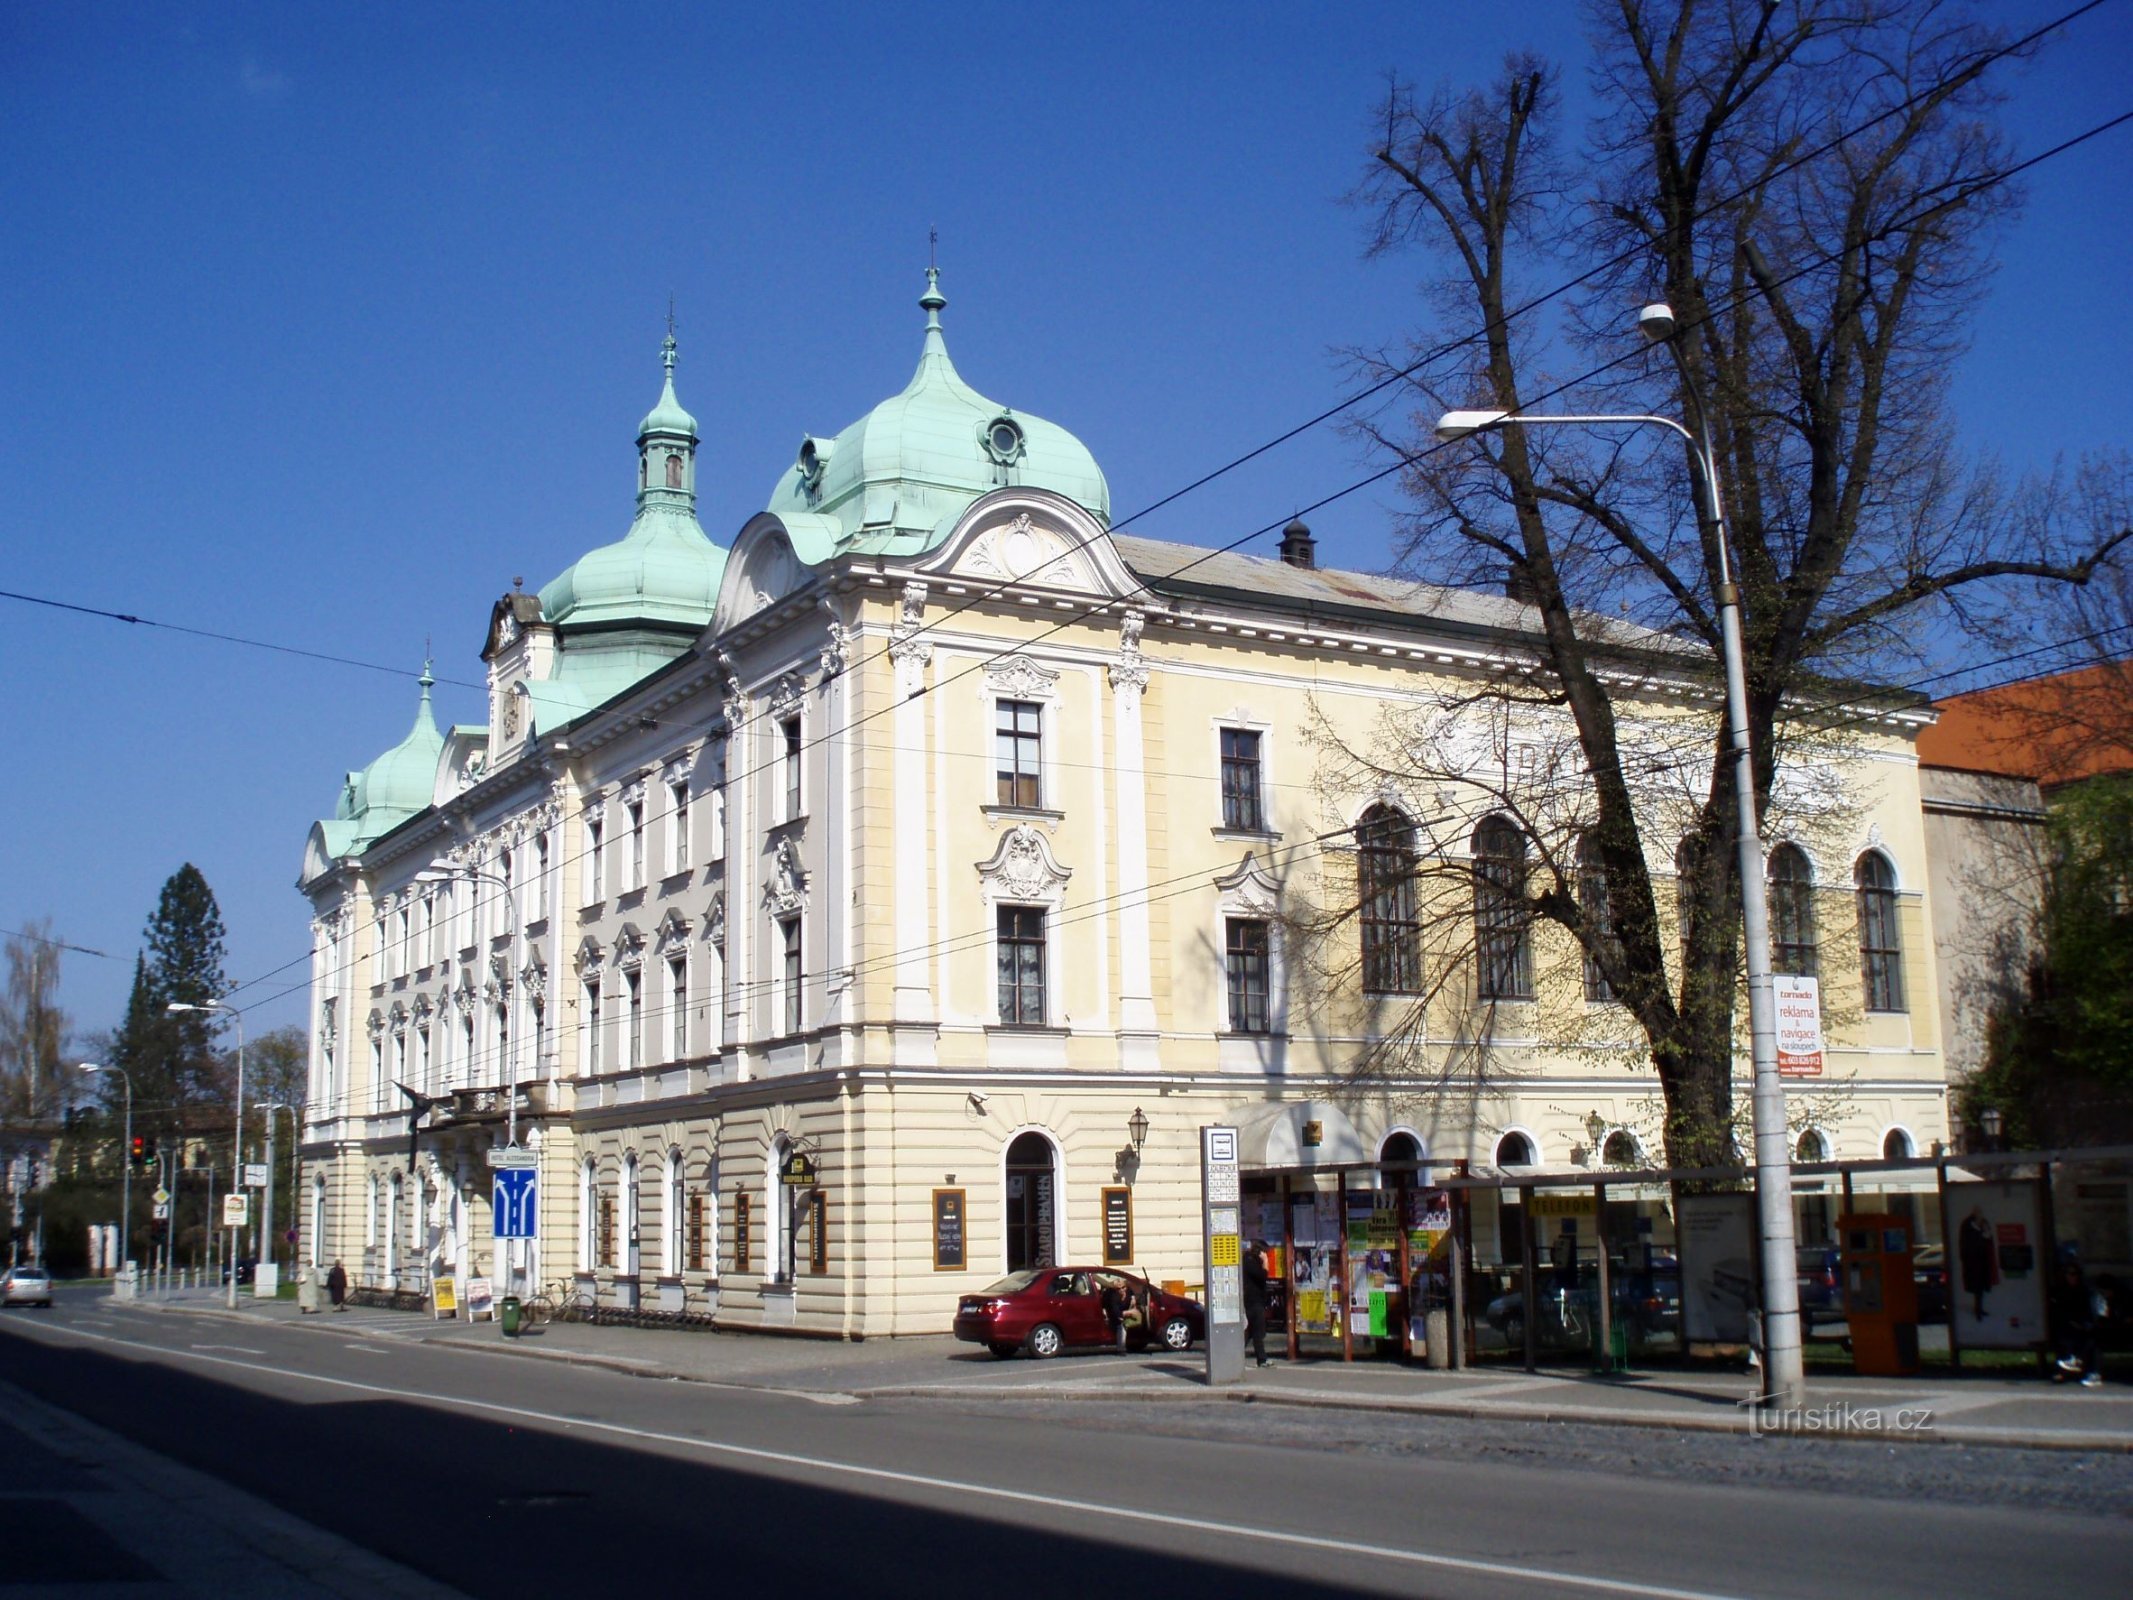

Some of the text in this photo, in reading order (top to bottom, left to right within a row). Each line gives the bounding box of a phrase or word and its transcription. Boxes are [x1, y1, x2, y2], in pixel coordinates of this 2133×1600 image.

[1780, 991, 1812, 999] tornado
[1780, 1005, 1814, 1018] reklama
[1780, 1028, 1816, 1041] navigace
[1534, 1200, 1590, 1212] TELEFON
